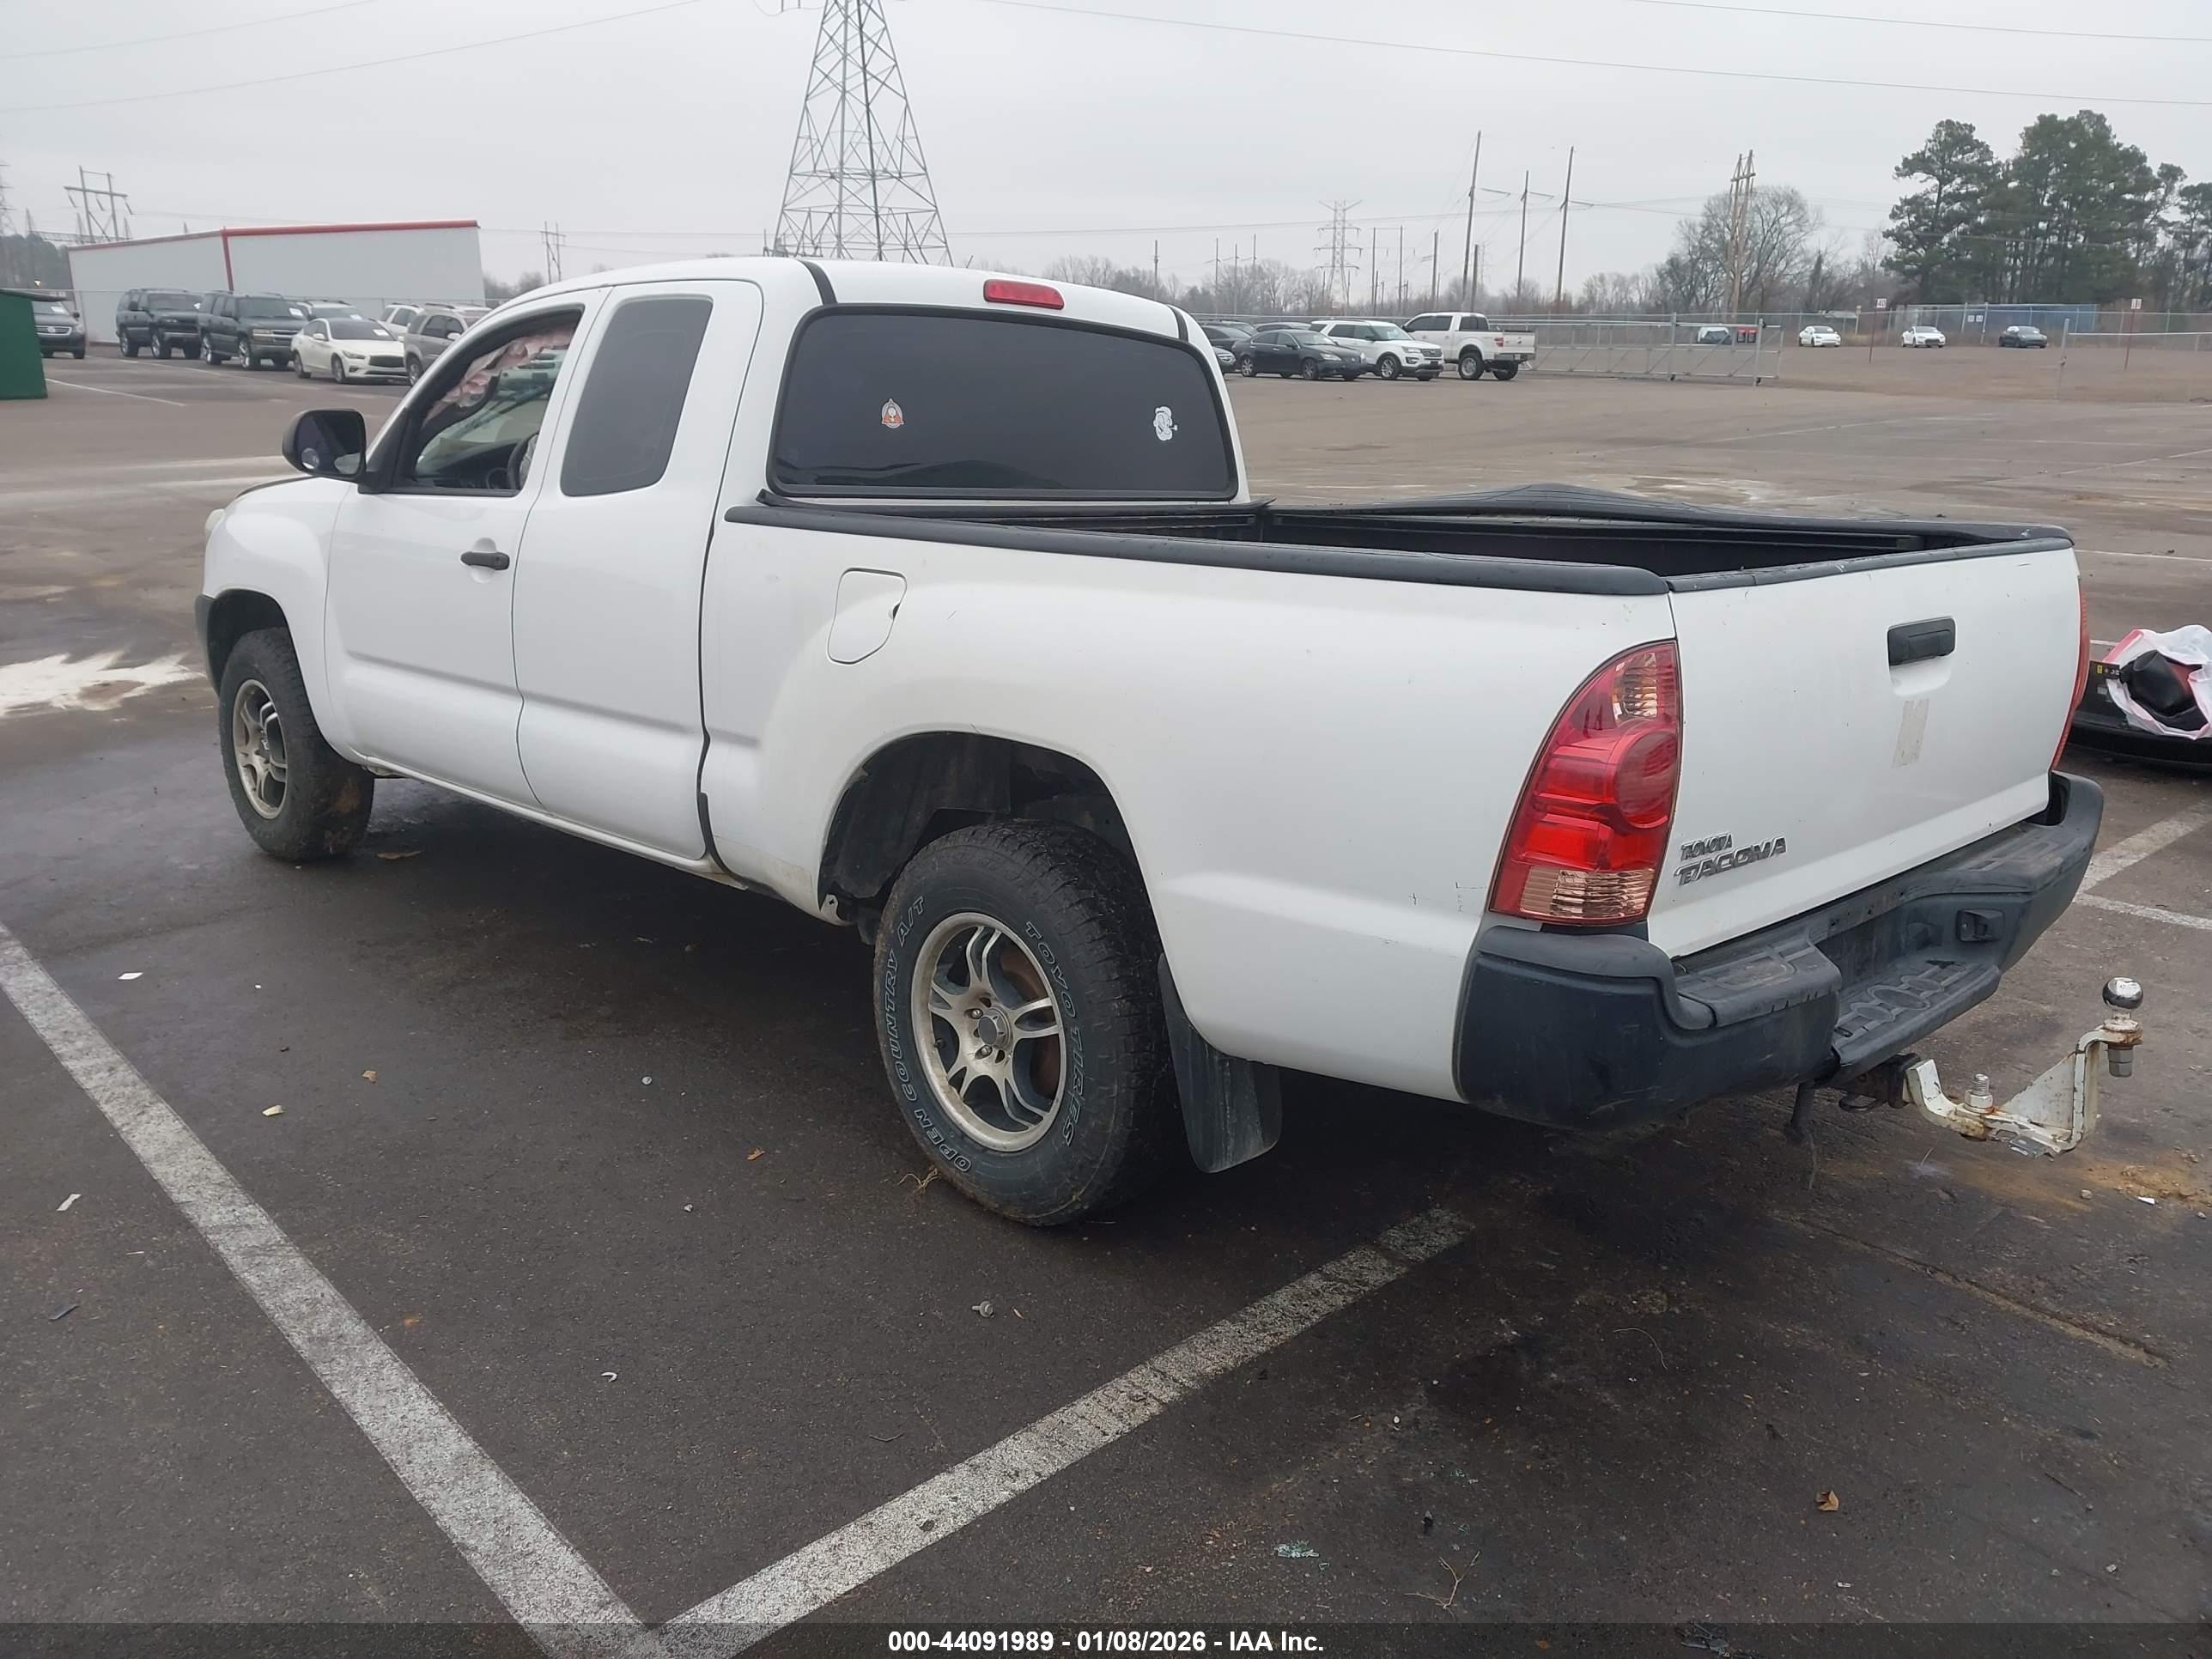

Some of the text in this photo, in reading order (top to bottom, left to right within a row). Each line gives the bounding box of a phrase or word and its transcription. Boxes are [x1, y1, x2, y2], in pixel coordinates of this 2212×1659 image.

[1674, 836, 1787, 886] TACOMA
[1680, 831, 1733, 860] TOYOTA
[885, 896, 971, 1172] OPEN COUNTRY A/T
[1026, 921, 1084, 1147] TOYO TIRES
